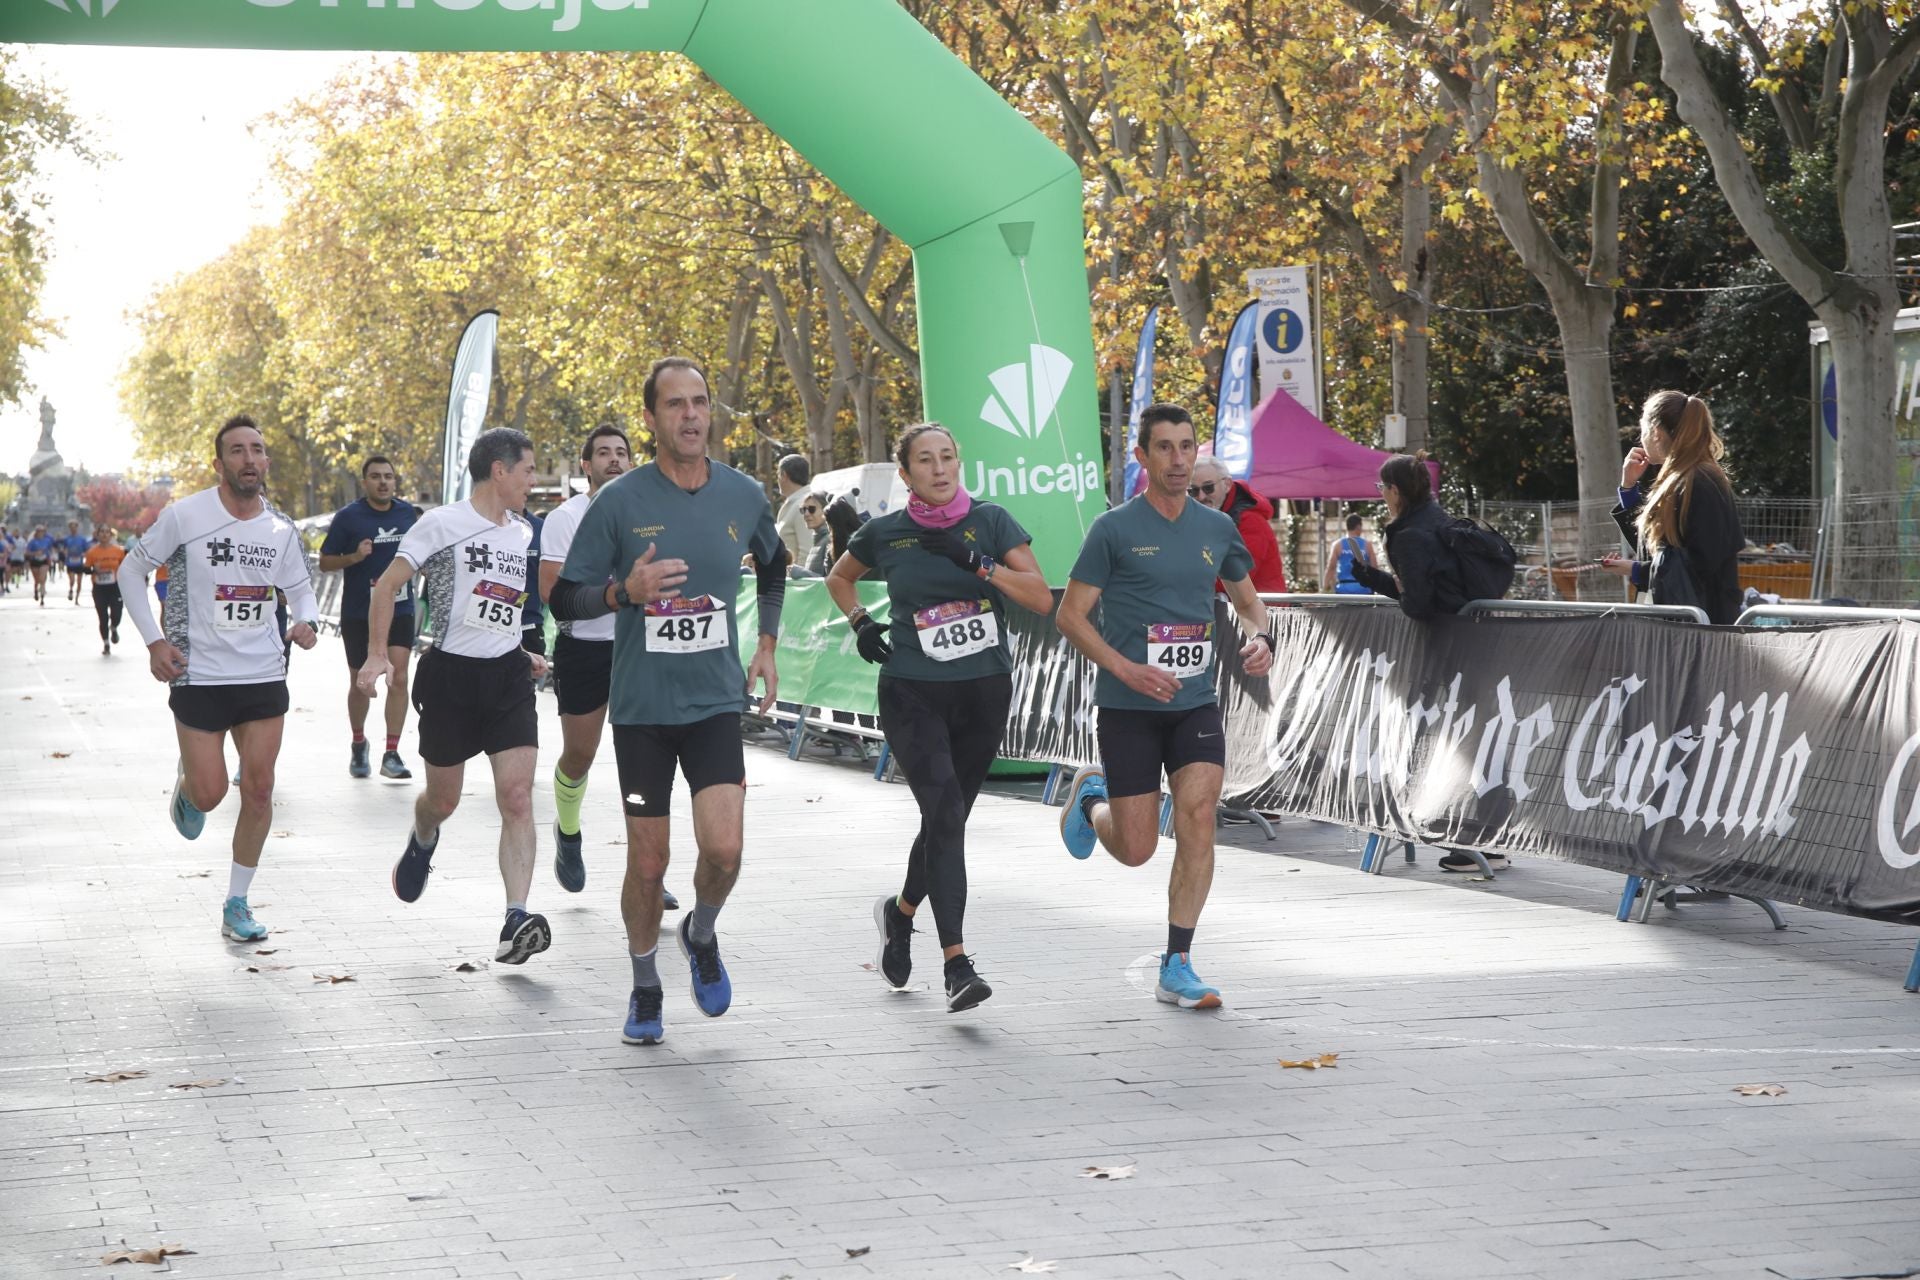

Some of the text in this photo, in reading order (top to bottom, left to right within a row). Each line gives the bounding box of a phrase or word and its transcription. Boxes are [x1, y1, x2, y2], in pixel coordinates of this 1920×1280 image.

[1223, 345, 1249, 476] IVECO
[958, 452, 1099, 502] Unicaja
[633, 524, 665, 534] GUARDIA
[237, 544, 277, 558] CUATRO
[889, 538, 919, 547] GUARDIA
[240, 556, 272, 569] RAYAS
[498, 563, 526, 578] RAYAS
[224, 602, 262, 621] 151
[478, 599, 514, 627] 153
[657, 615, 713, 641] 487
[932, 619, 986, 649] 488
[1157, 645, 1204, 668] 489
[1469, 675, 1555, 804] de
[1563, 672, 1812, 842] Castilla
